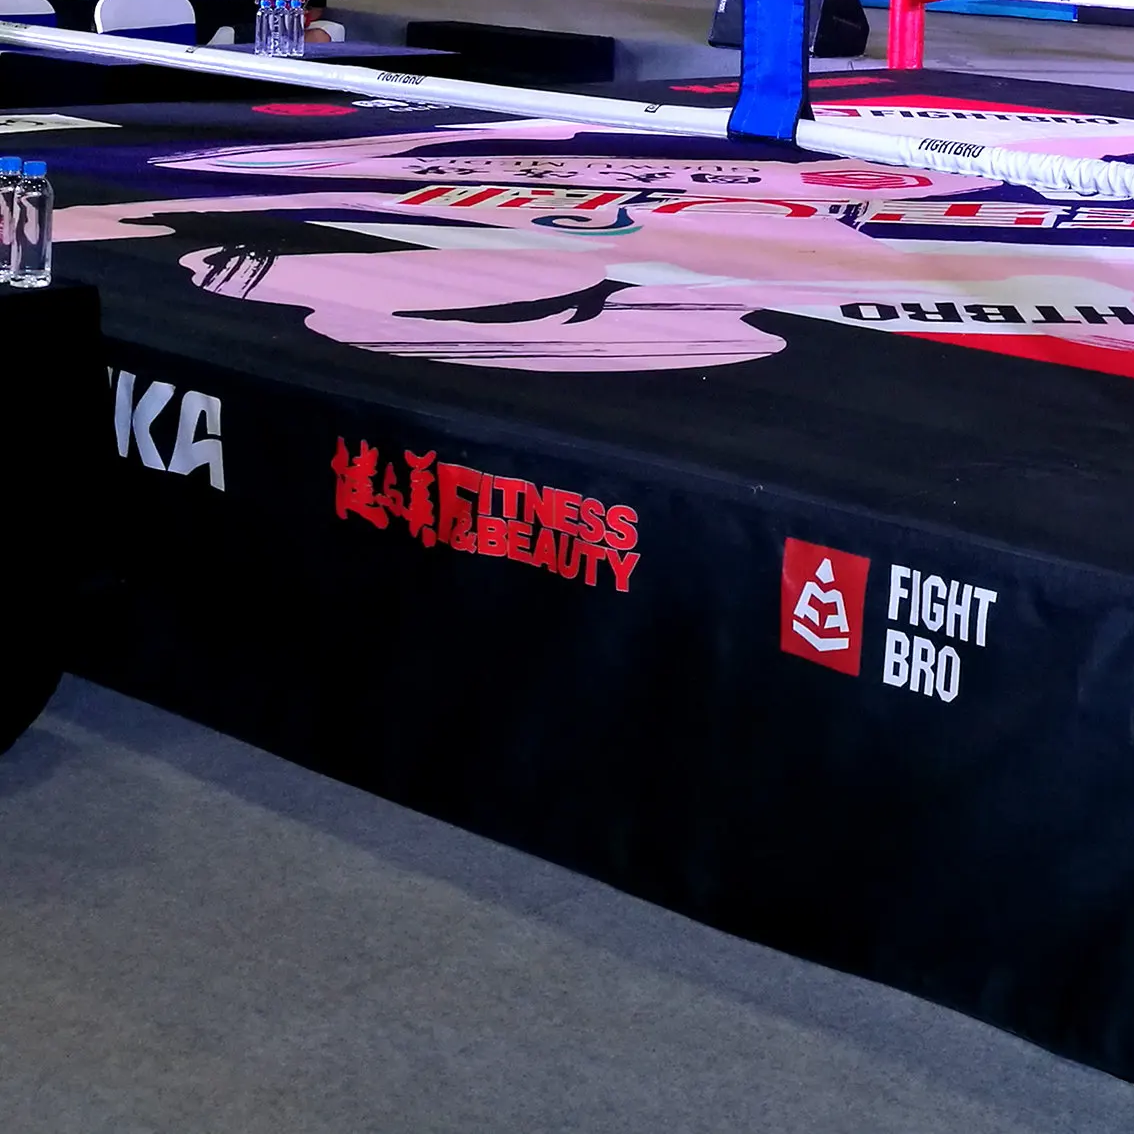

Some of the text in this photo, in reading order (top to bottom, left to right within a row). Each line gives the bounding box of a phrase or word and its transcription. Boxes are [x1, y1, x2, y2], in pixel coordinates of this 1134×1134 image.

[871, 109, 1120, 126] FIGHTBRO
[917, 137, 985, 159] FIGHTBRO
[107, 367, 225, 491] KA
[437, 461, 640, 551] FITNESS
[450, 509, 640, 593] &BEAUTY
[887, 563, 998, 648] FIGHT
[882, 628, 961, 704] BRO
